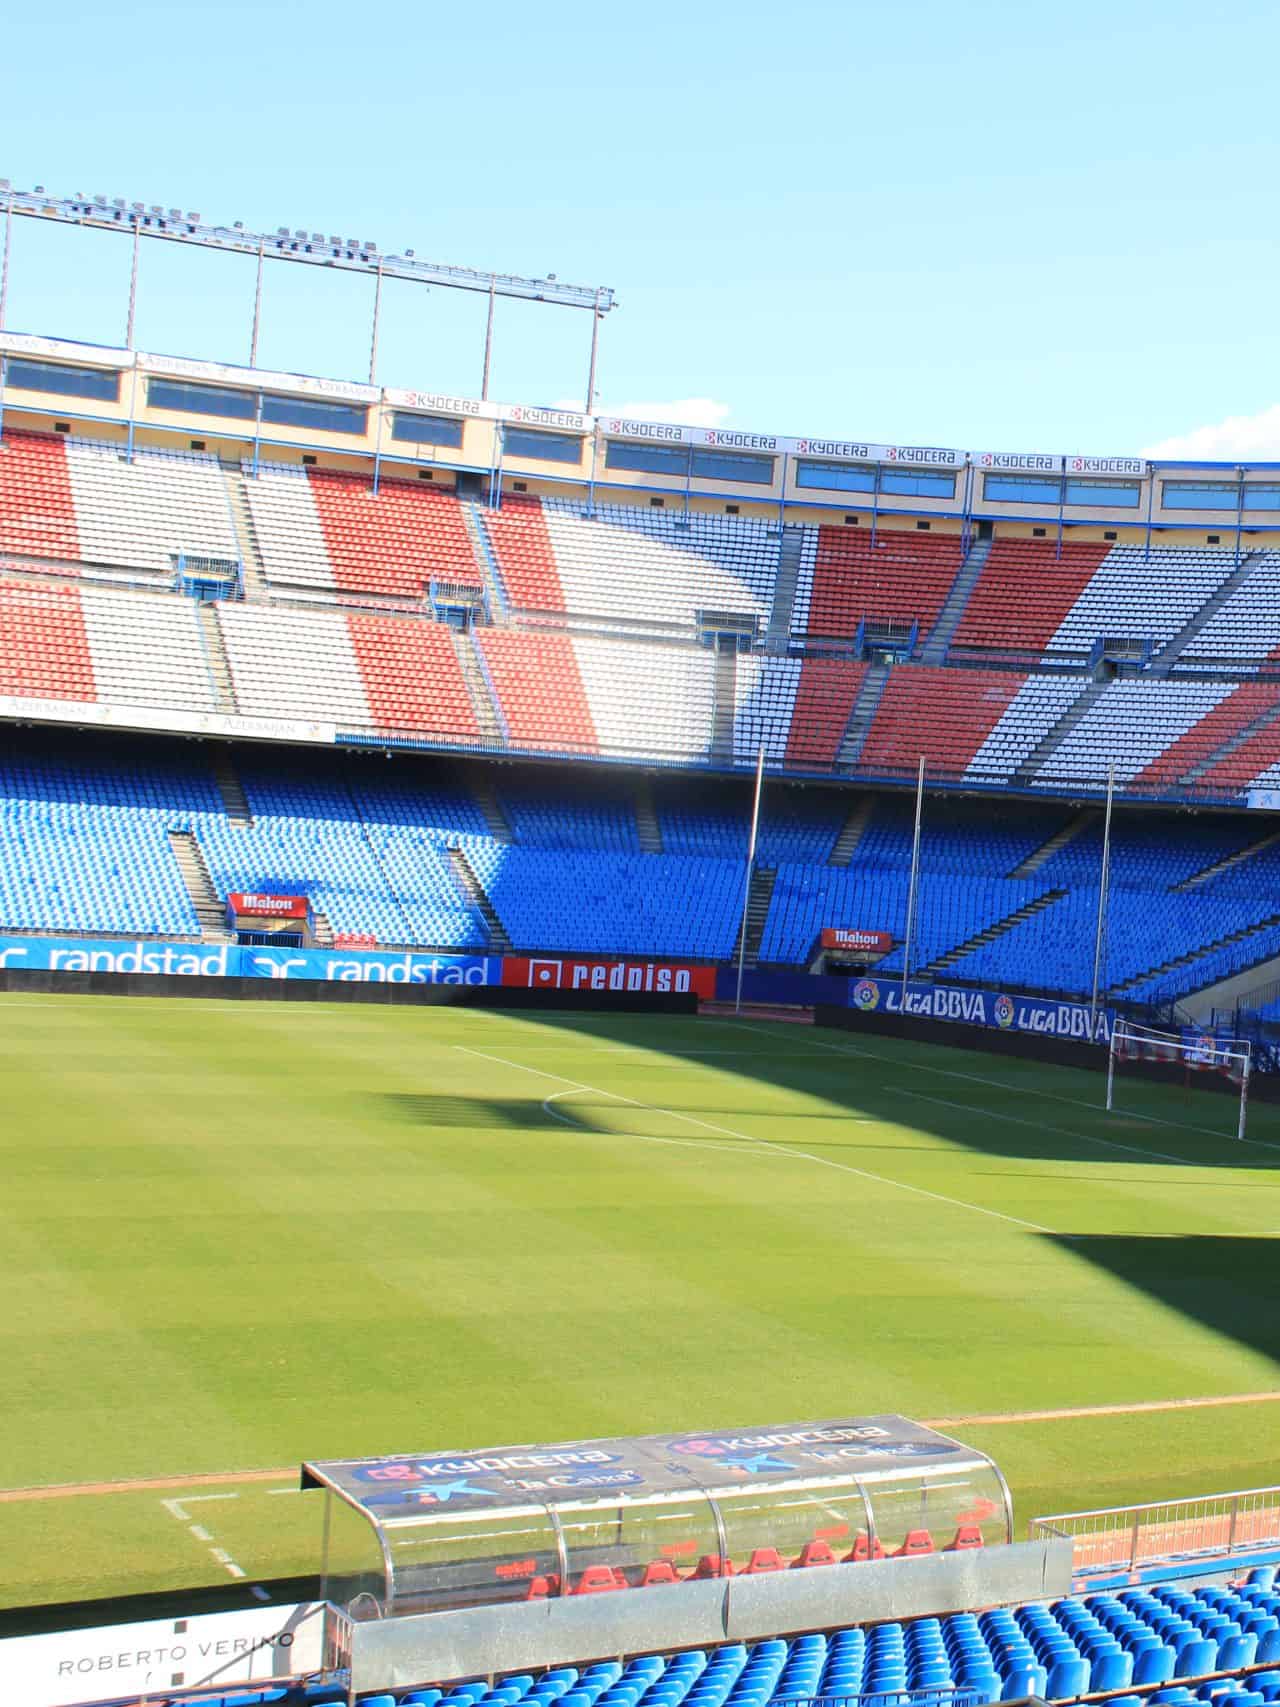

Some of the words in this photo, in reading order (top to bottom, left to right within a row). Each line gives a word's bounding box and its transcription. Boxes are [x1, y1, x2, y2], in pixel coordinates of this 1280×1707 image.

[416, 394, 480, 414] KYOCERA
[522, 407, 584, 428] KYOCERA
[621, 422, 683, 441] KYOCERA
[716, 433, 777, 450] KYOCERA
[808, 441, 868, 457] KYOCERA
[897, 449, 956, 464] KYOCERA
[993, 455, 1053, 470] KYOCERA
[1083, 460, 1141, 473] KYOCERA
[835, 930, 878, 945] Mahou
[49, 943, 227, 977] randstad
[326, 951, 488, 986] randstad
[719, 1426, 891, 1450] KYOCERA
[419, 1450, 612, 1476] KYOCERA
[58, 1646, 187, 1676] ROBERTO
[198, 1632, 295, 1657] VERINO
